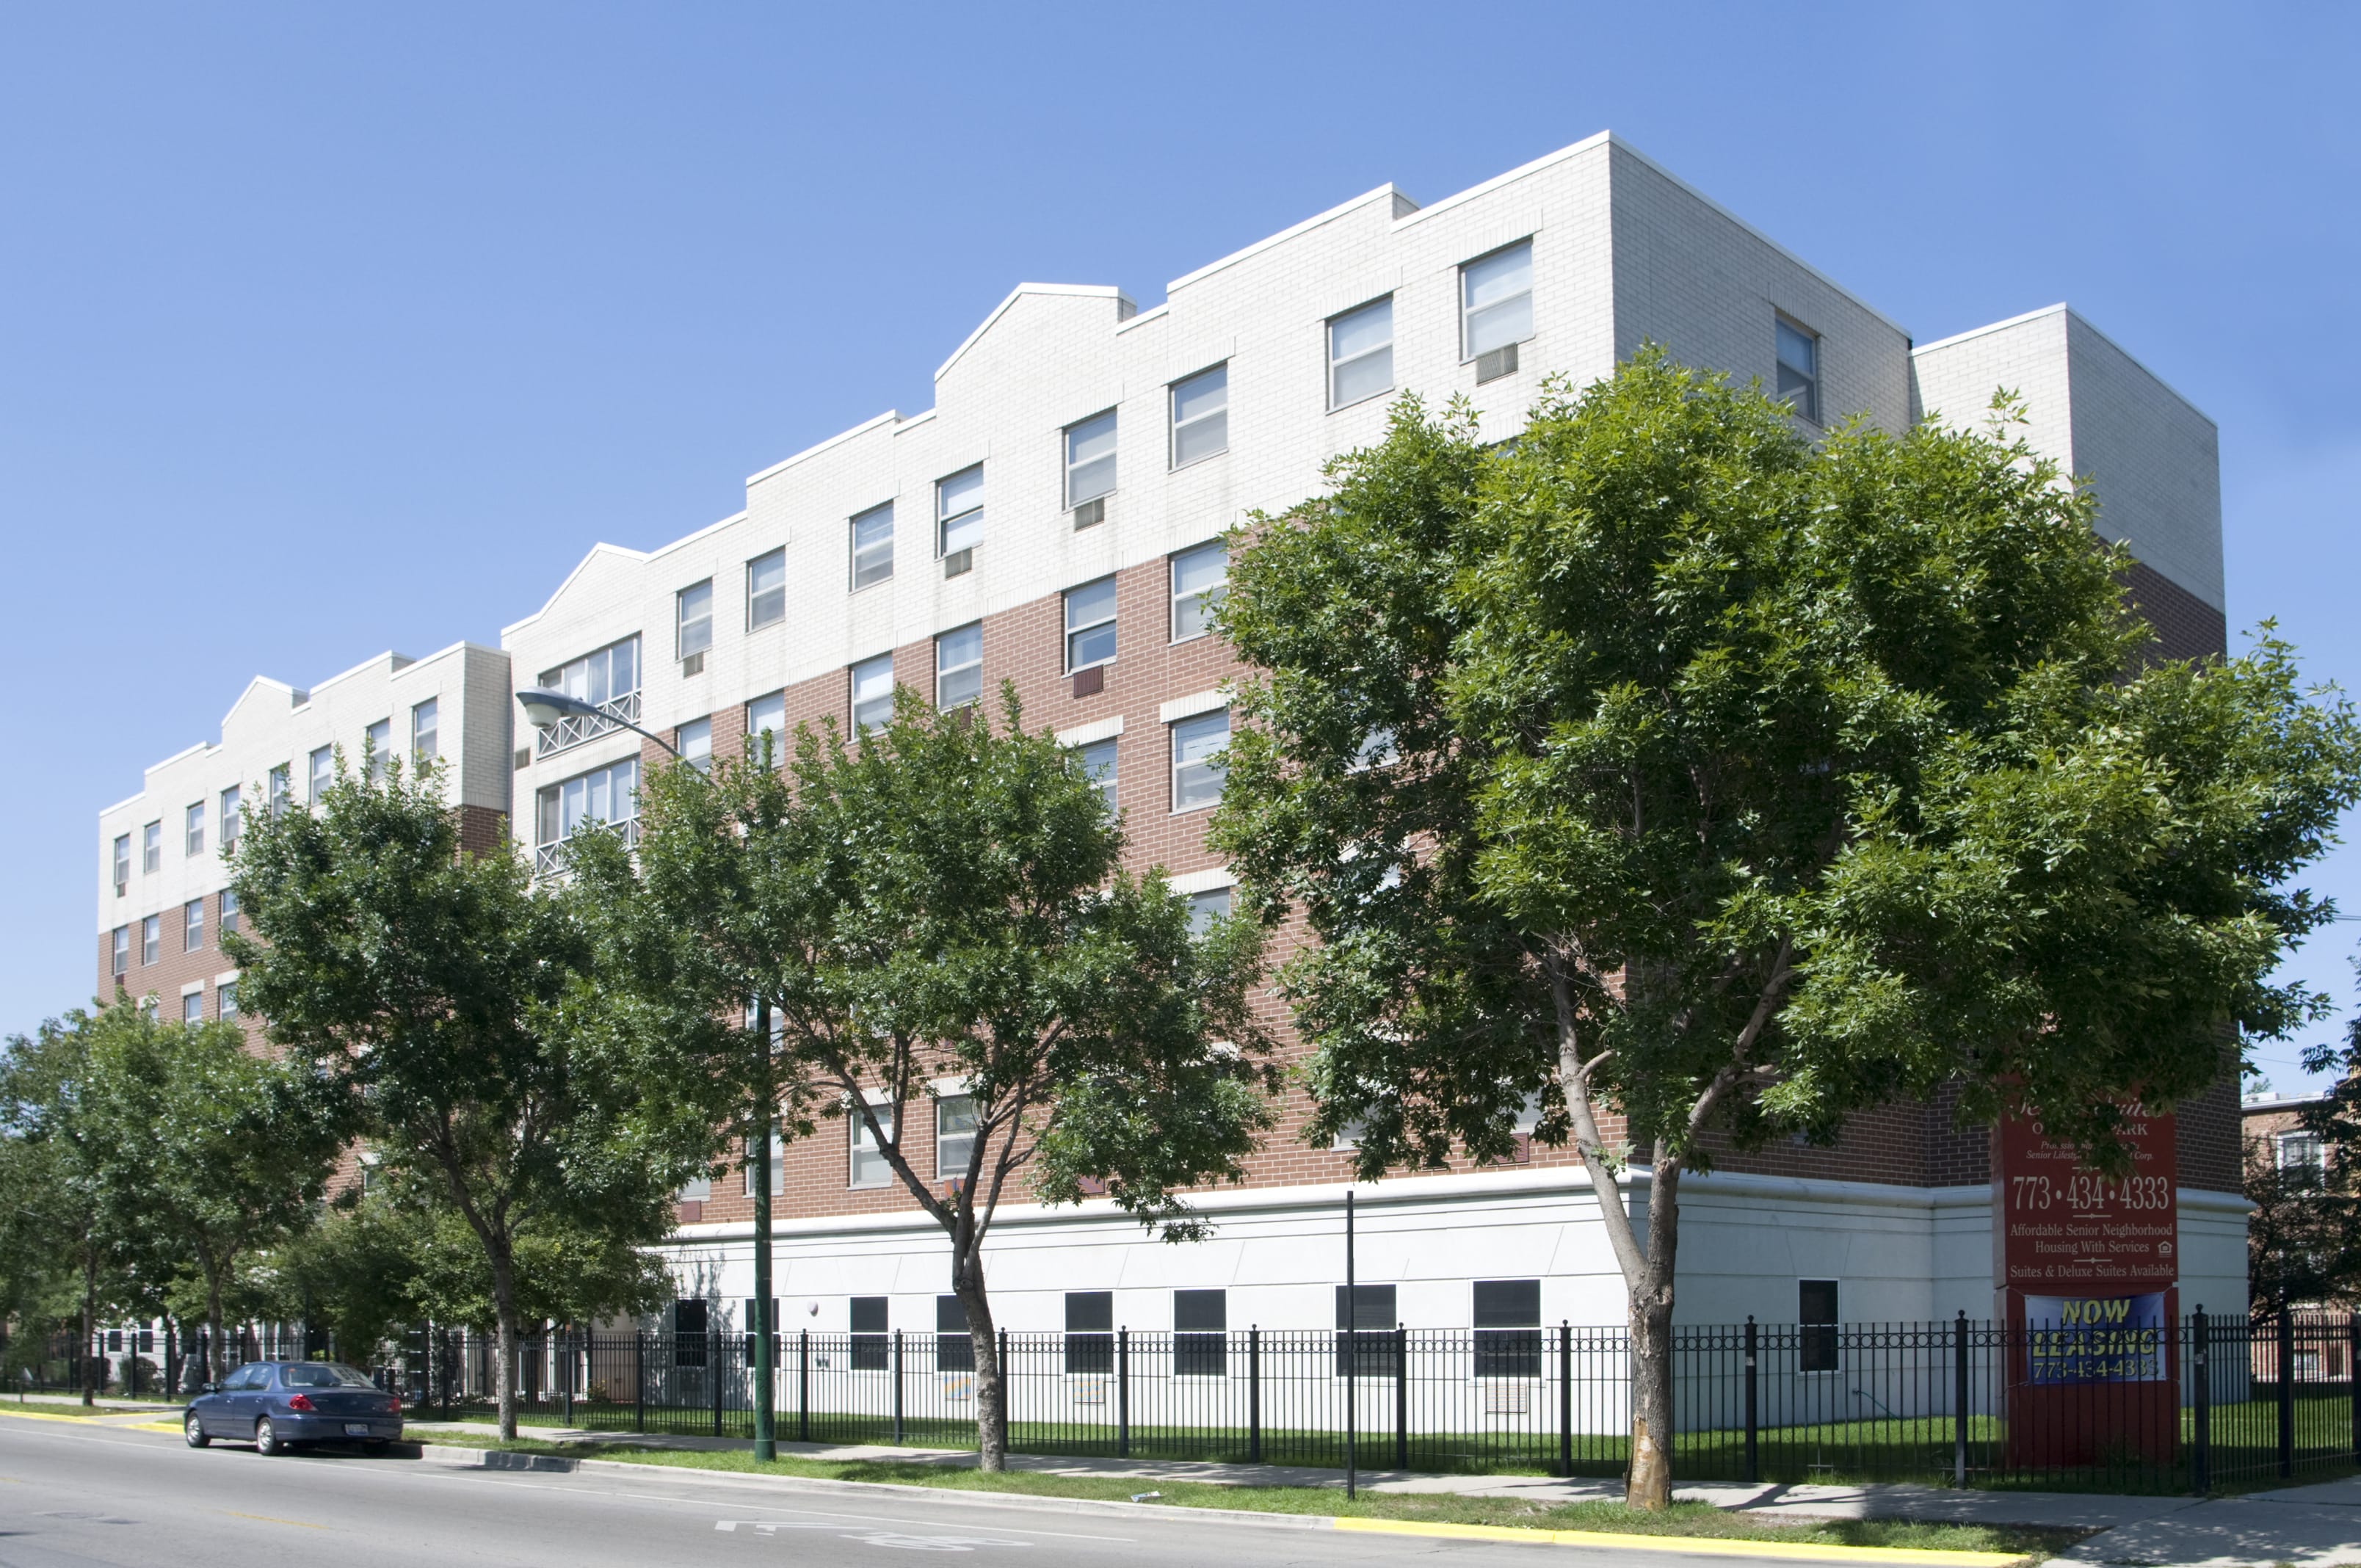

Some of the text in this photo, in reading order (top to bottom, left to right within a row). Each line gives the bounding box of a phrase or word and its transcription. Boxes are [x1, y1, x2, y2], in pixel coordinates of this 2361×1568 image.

[2026, 1150, 2051, 1159] Senior
[2010, 1223, 2172, 1238] Affordable Senior Neighborhood
[2035, 1241, 2150, 1255] Housing With Services
[2010, 1263, 2175, 1277] Suites & Deluxe Suites Available
[2061, 1299, 2130, 1325] NOW
[2032, 1329, 2156, 1358] LEASING
